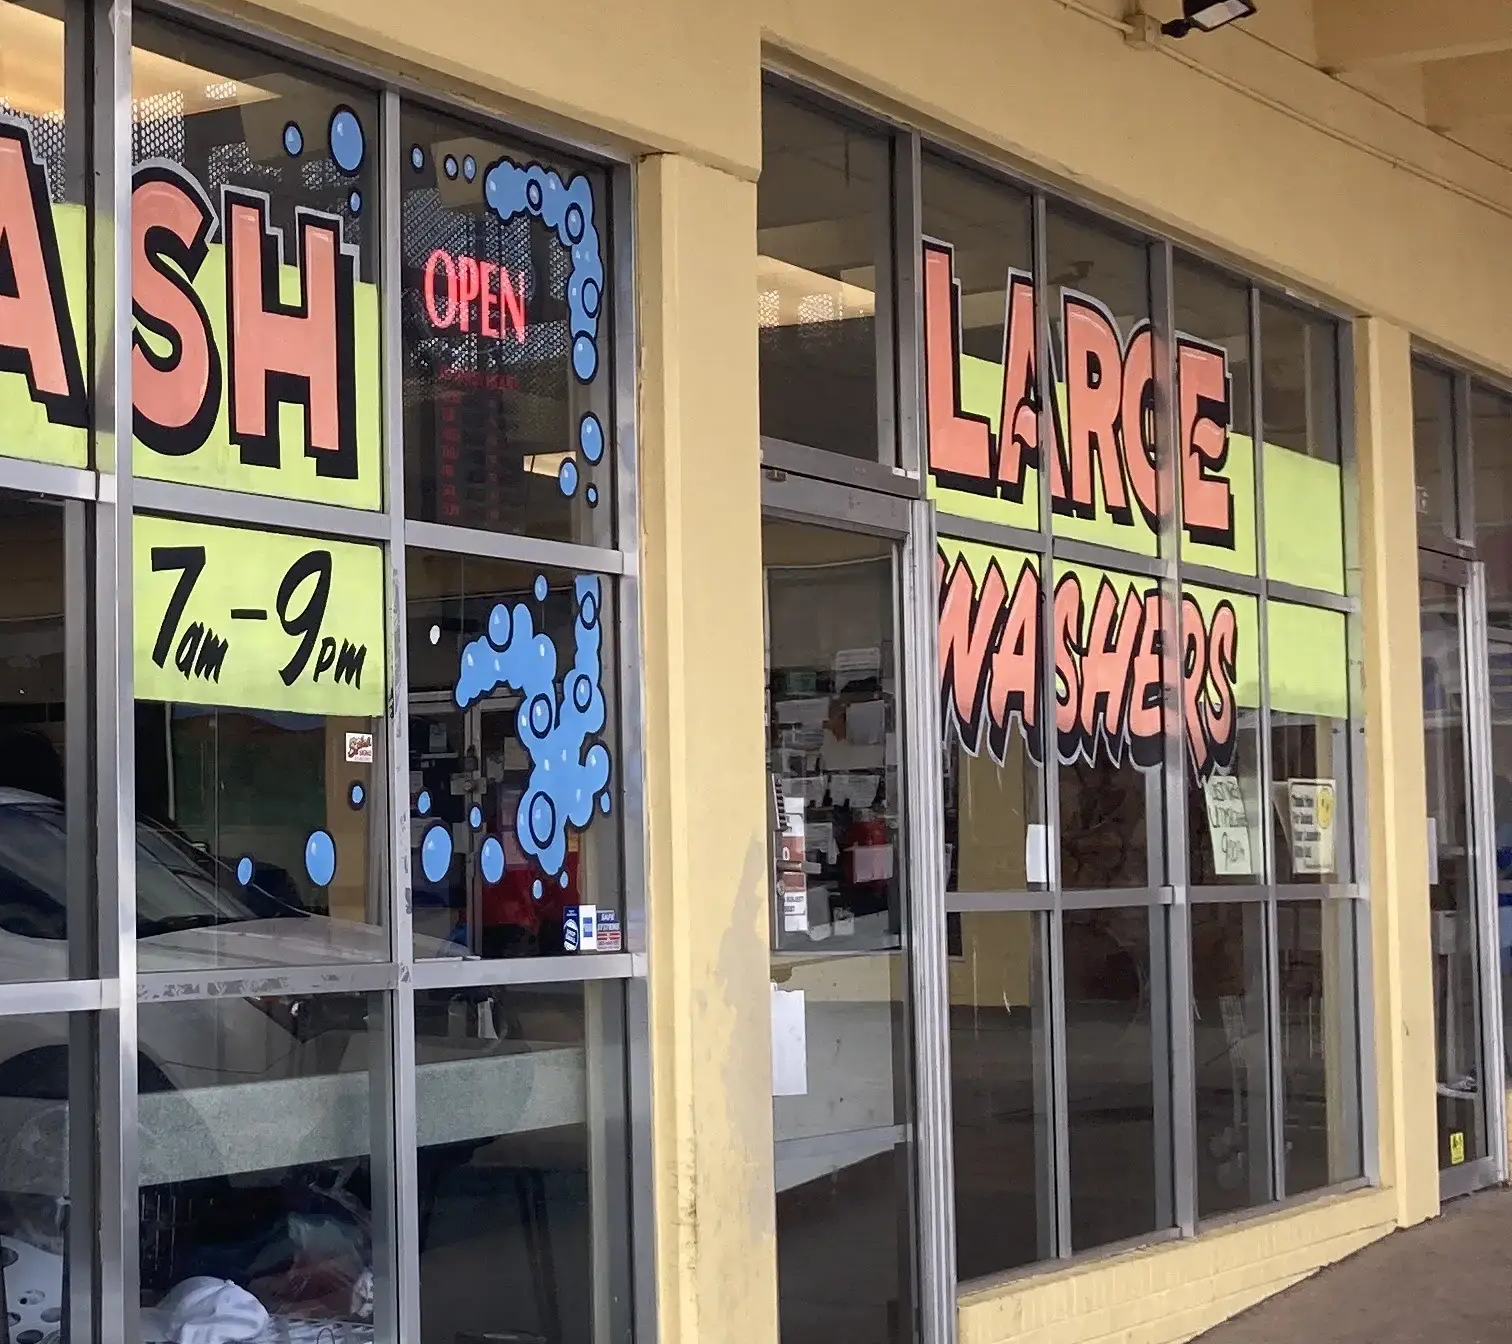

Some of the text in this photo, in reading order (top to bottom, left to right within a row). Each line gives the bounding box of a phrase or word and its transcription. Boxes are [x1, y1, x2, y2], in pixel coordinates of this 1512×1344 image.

[424, 248, 526, 345] OPEN
[921, 236, 1235, 550] LARGE
[937, 539, 1238, 786] WASHERS
